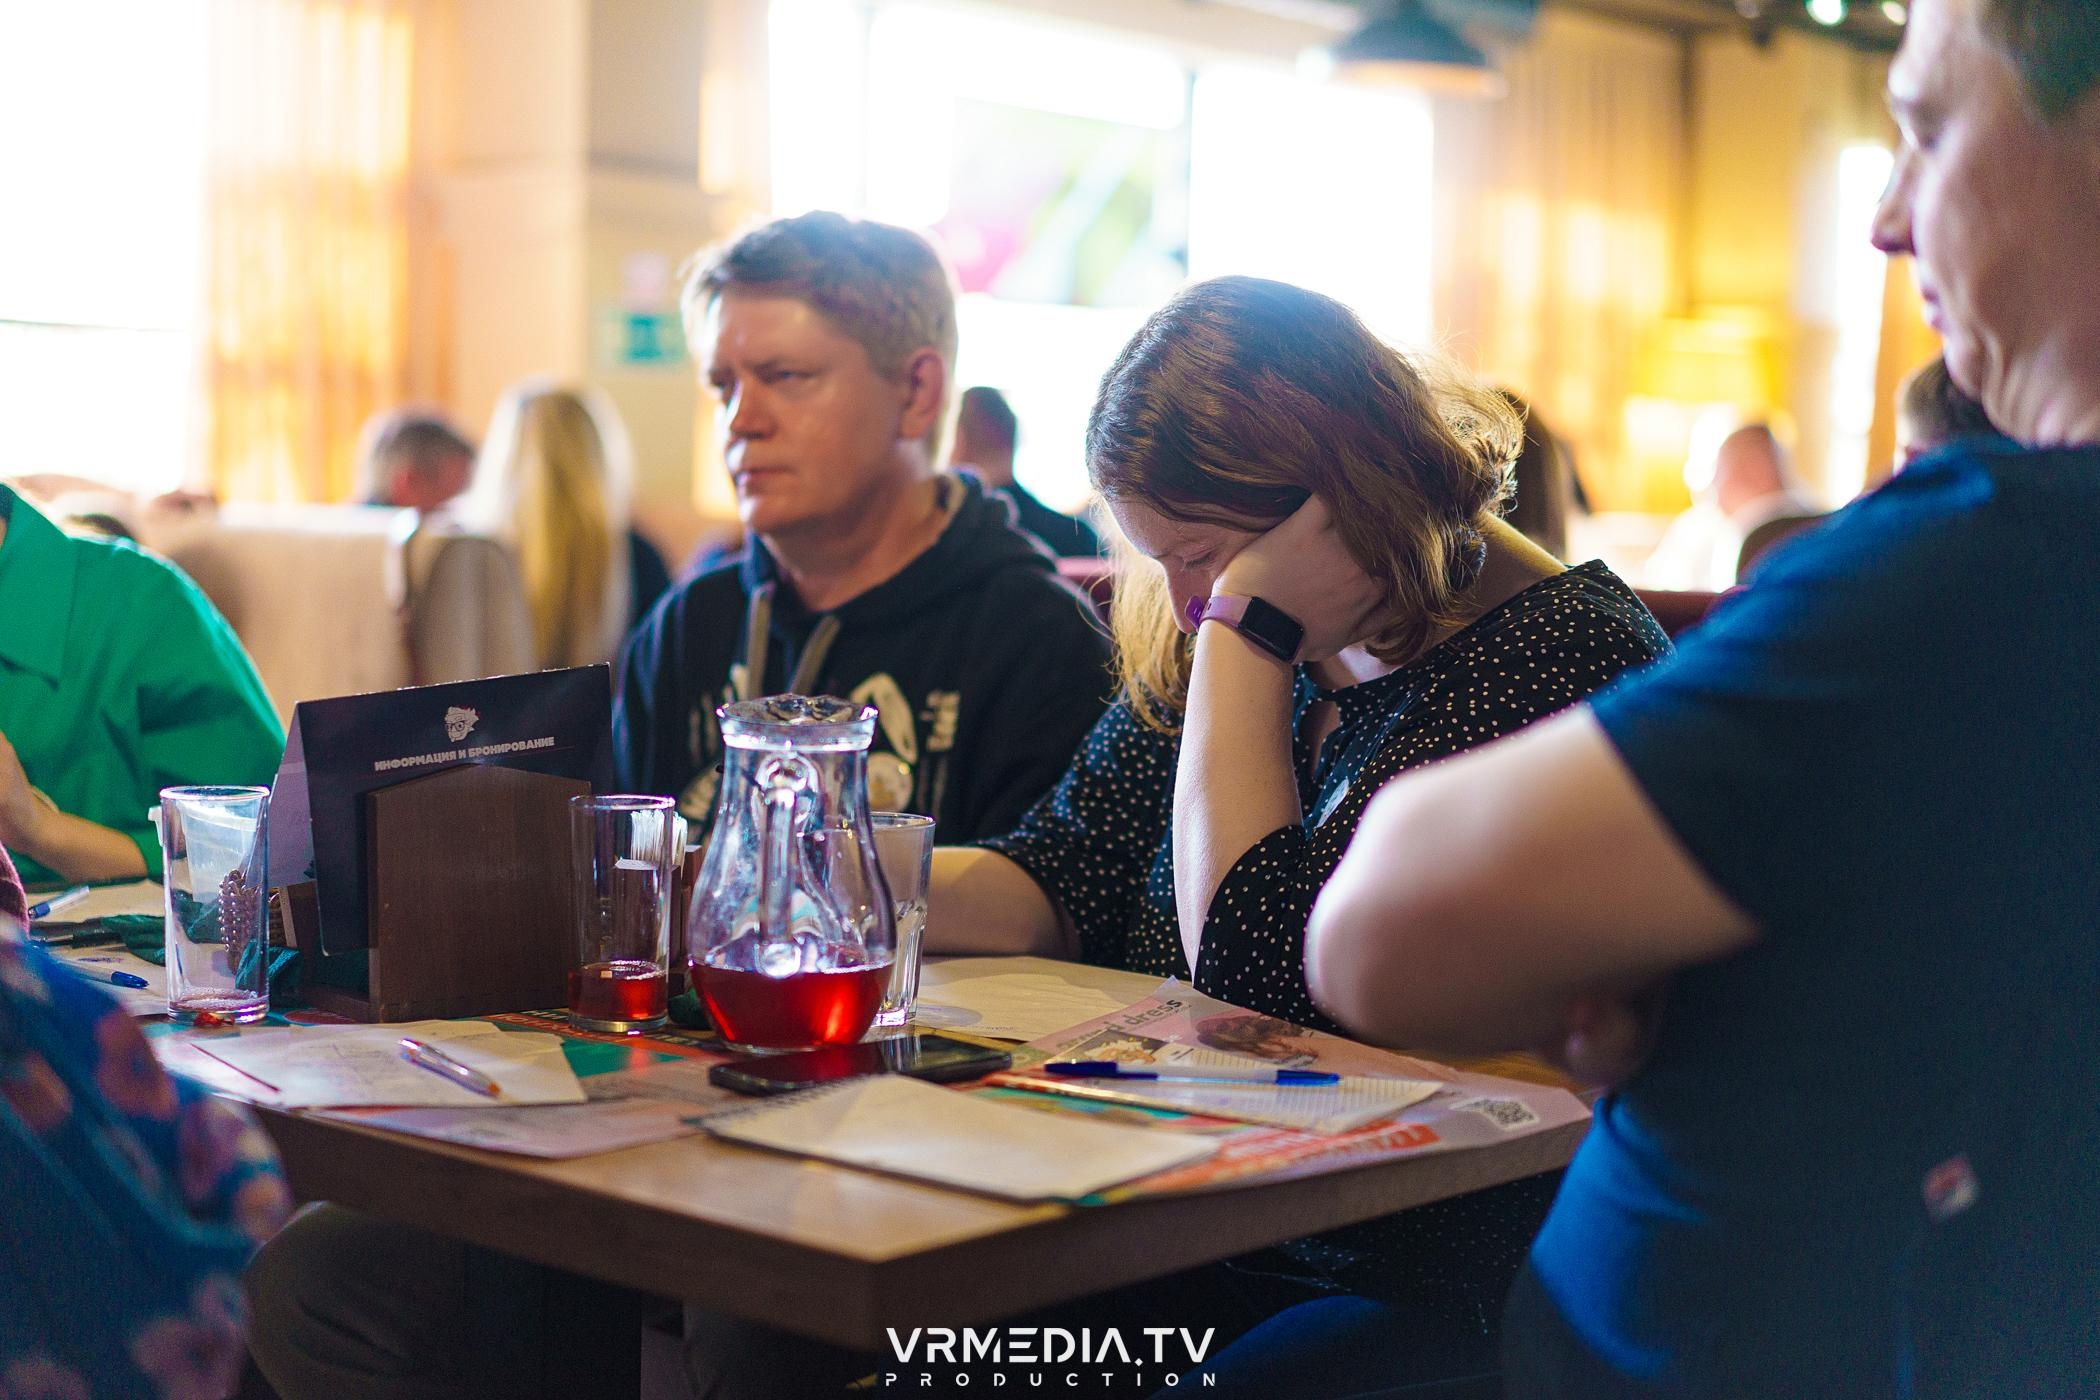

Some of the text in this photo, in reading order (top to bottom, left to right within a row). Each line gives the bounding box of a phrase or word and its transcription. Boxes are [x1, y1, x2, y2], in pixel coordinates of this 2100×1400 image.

[374, 736, 555, 771] ИНФОРМАЦИЯ И БРОНИРОВАНИЕ
